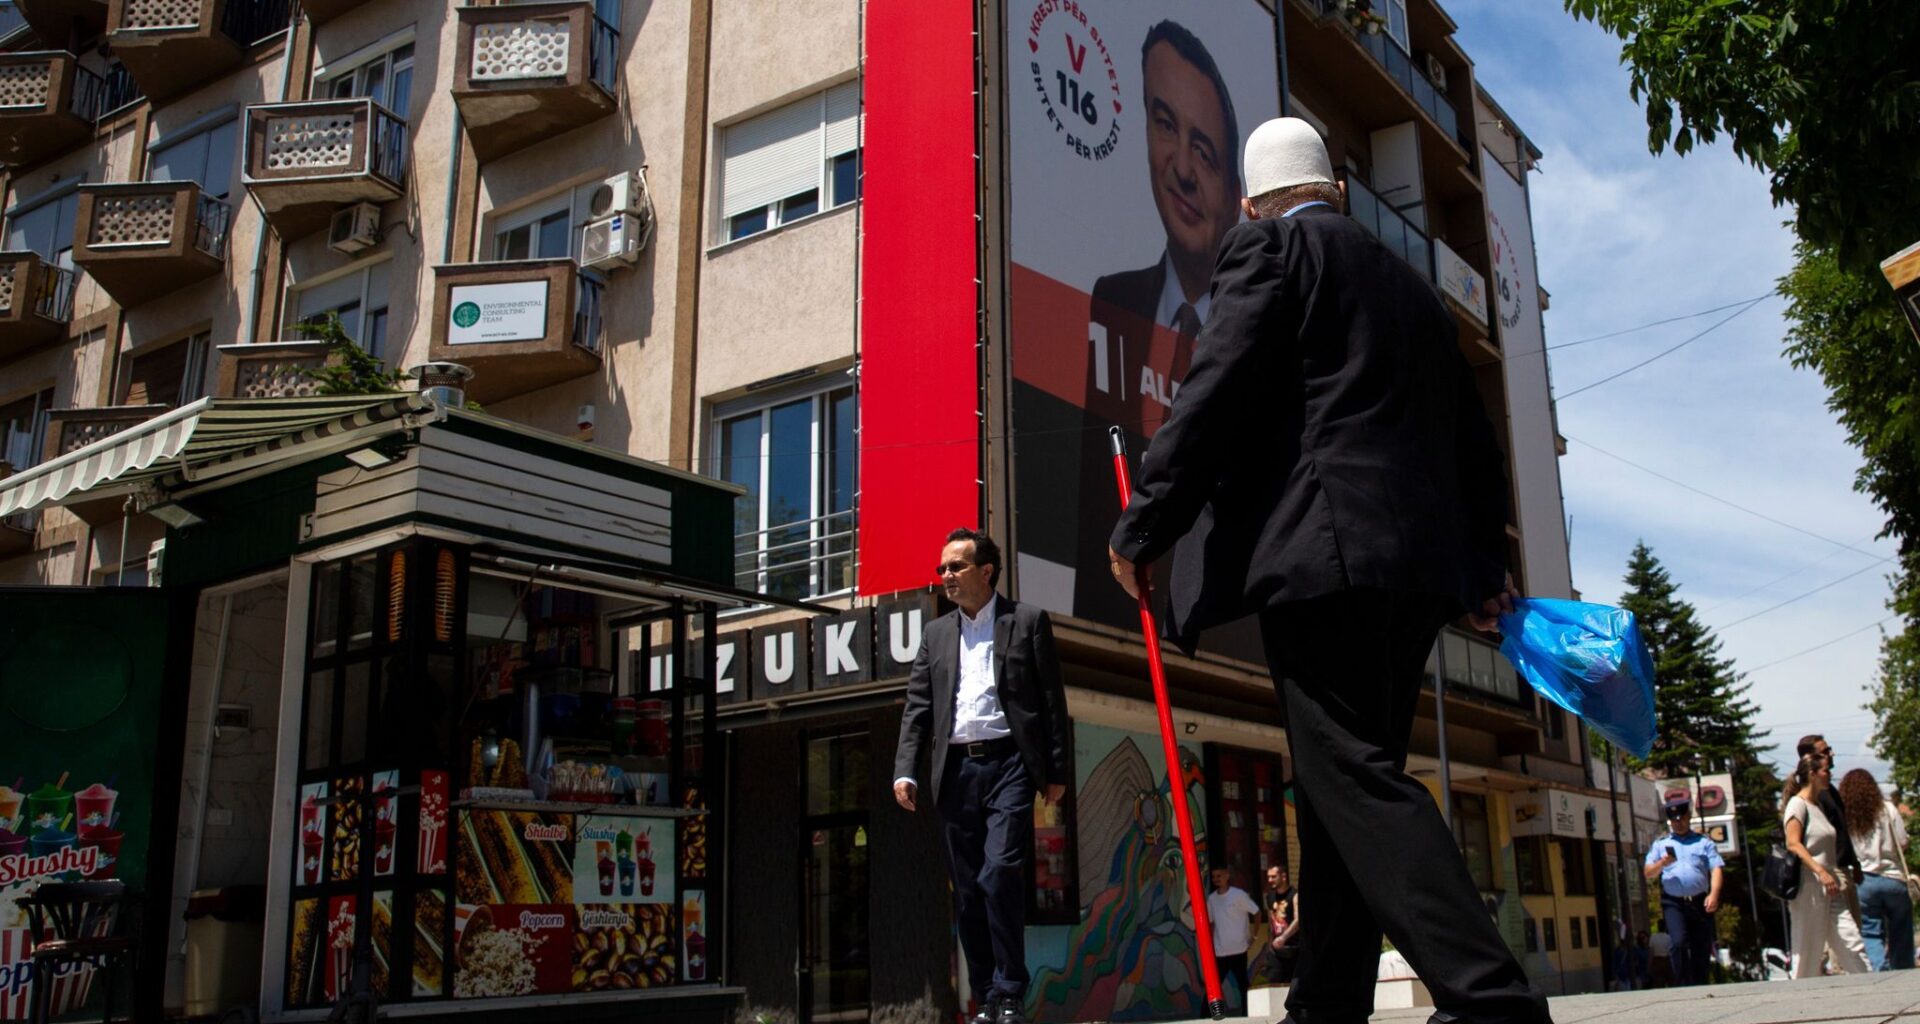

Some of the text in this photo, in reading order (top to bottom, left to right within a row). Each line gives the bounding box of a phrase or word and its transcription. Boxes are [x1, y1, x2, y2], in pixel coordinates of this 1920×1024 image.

[1030, 0, 1060, 37] KREJT
[1090, 26, 1120, 96] SHTET
[1065, 31, 1087, 75] V
[1030, 61, 1121, 161] SHTET PËR KREJT
[1056, 69, 1098, 125] 116
[482, 308, 526, 317] CONSULTING
[483, 300, 543, 310] ENVIRONMENTAL
[1088, 320, 1110, 394] 1
[0, 846, 98, 883] Slushy
[520, 911, 564, 931] Popcorn
